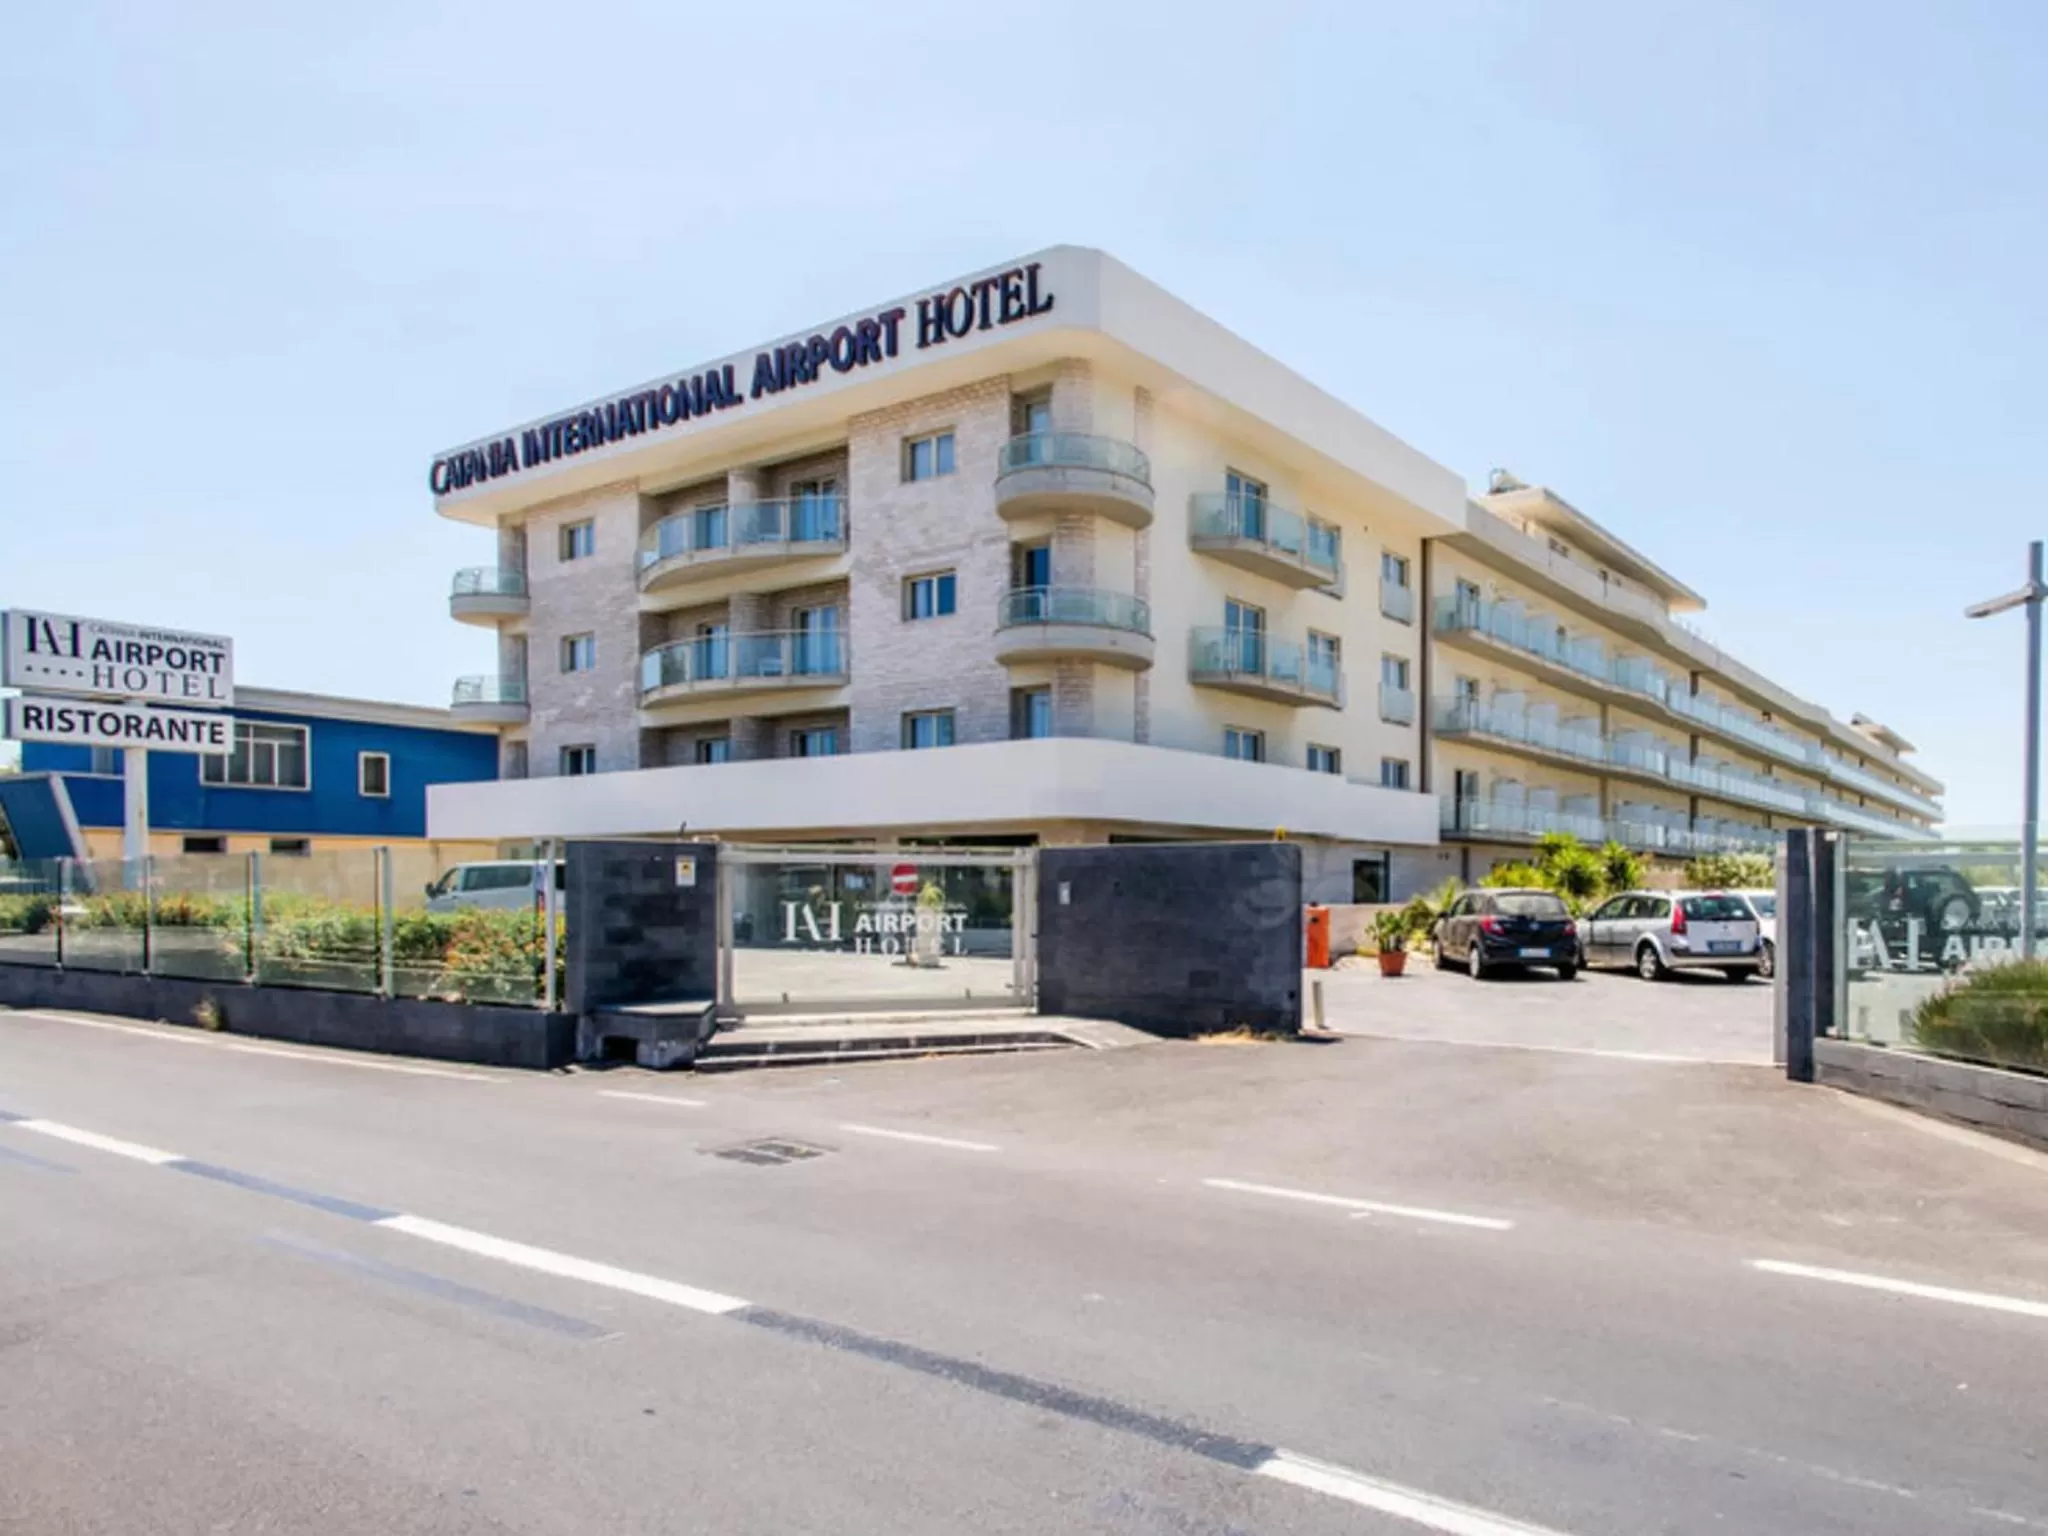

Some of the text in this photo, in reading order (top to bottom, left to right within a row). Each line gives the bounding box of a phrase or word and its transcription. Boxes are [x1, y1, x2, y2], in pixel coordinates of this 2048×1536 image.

[430, 262, 1054, 495] CATANIA INTERNATIONAL AIRPORT HOTEL
[91, 638, 226, 674] AIRPORT
[92, 665, 226, 699] HOTEL
[23, 705, 225, 745] RISTORANTE
[855, 913, 968, 932] AIRPORT
